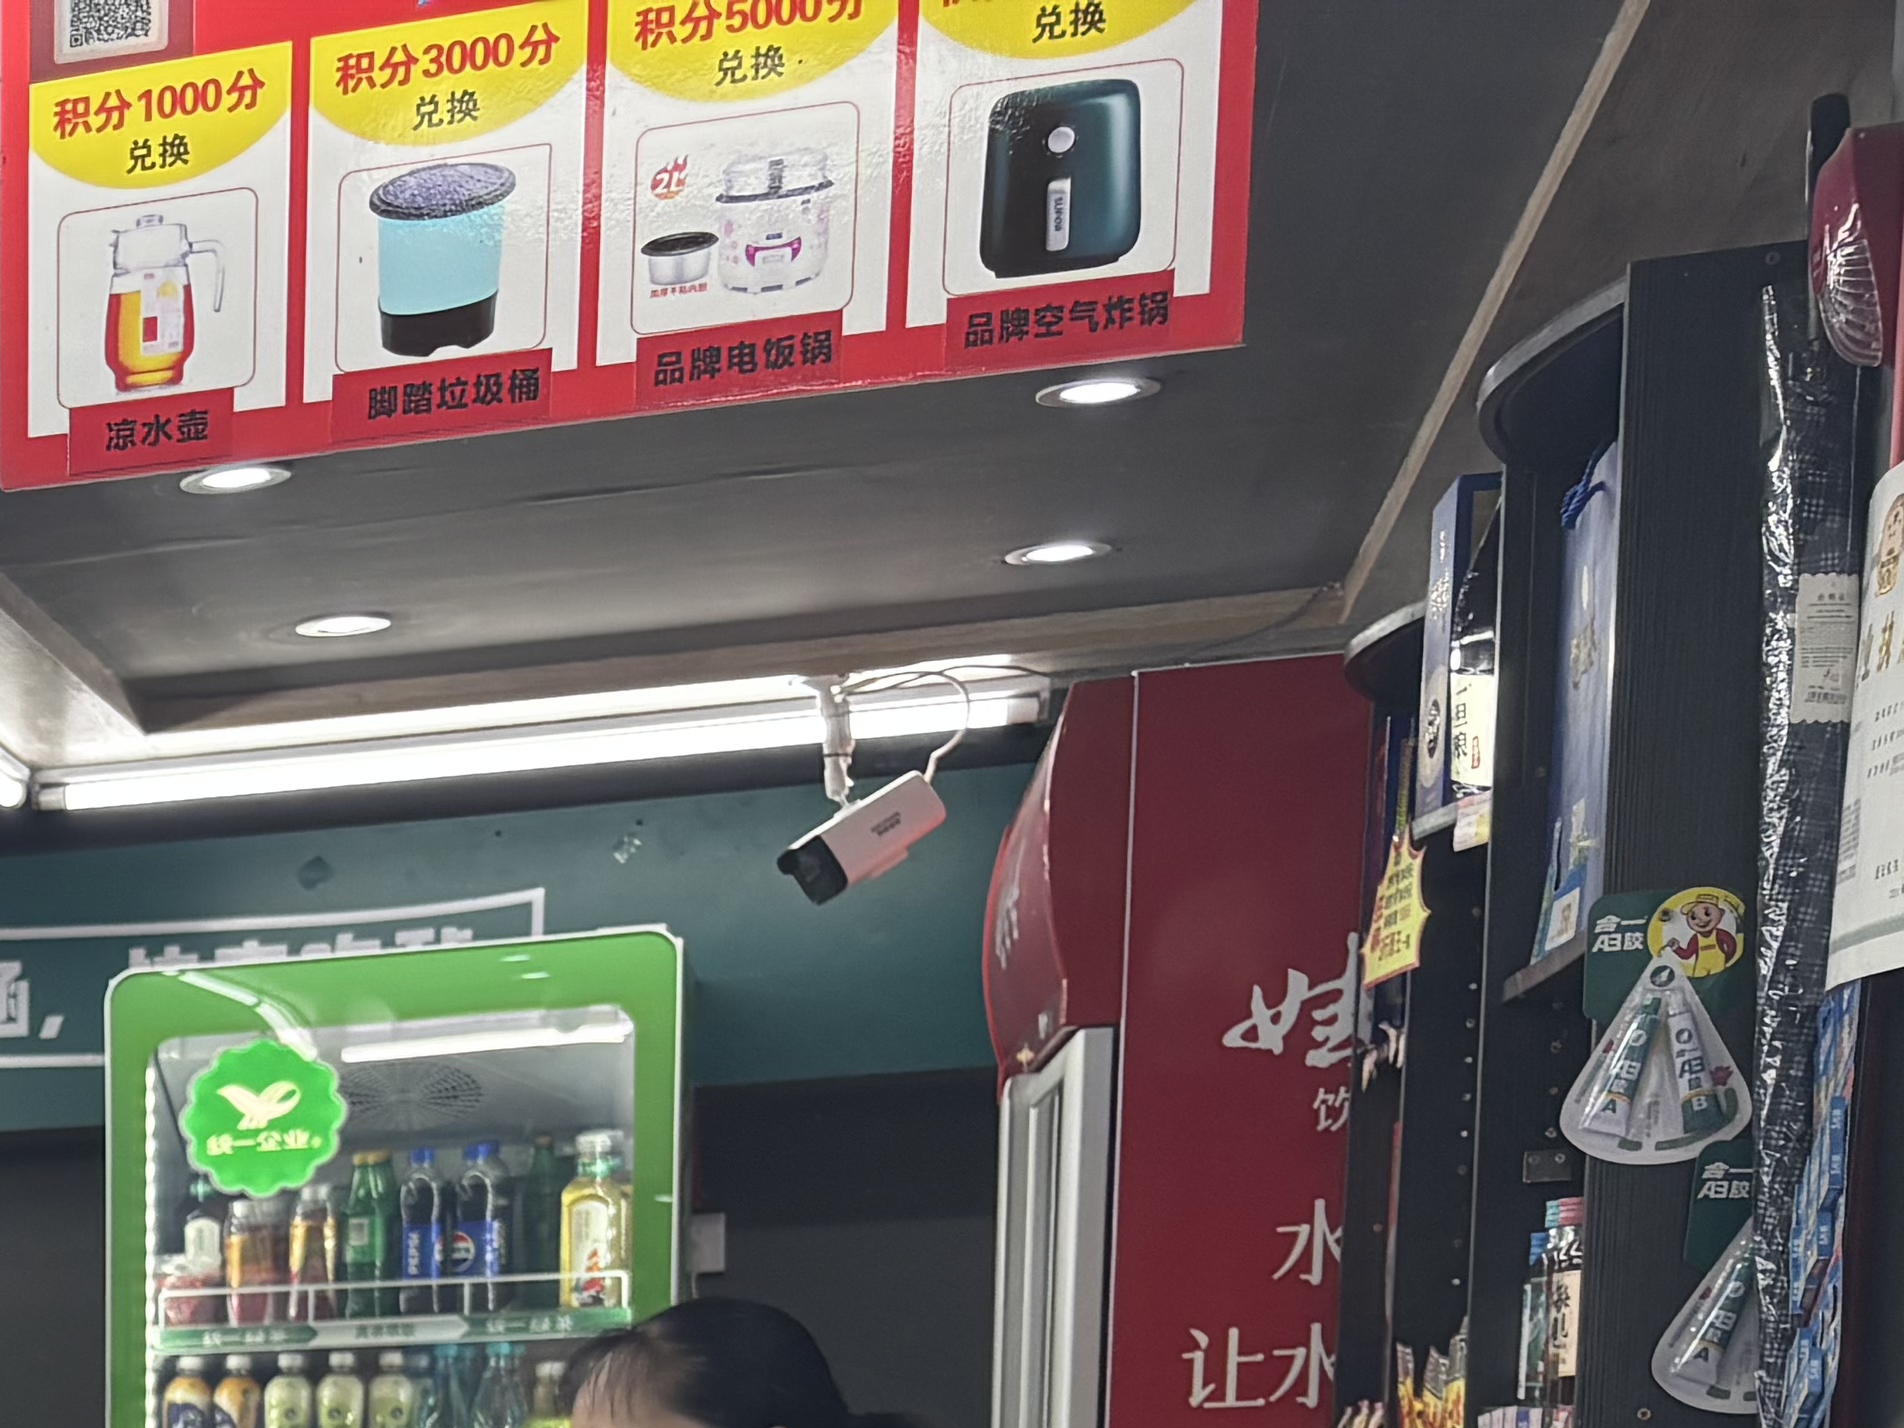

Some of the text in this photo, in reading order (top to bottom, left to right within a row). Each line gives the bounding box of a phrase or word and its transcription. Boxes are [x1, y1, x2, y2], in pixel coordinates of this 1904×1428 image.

[1032, 2, 1107, 44] 兑换
[335, 22, 561, 96] 积分3000分
[713, 45, 784, 88] 兑换
[53, 68, 266, 140] 积分1000分
[413, 92, 481, 131] 兑换
[126, 133, 191, 175] 兑换
[964, 291, 1169, 348] 品牌空气炸锅
[653, 330, 834, 388] 品牌电饭锅
[367, 367, 541, 420] 脚踏垃圾桶
[105, 410, 210, 453] 凉水壶
